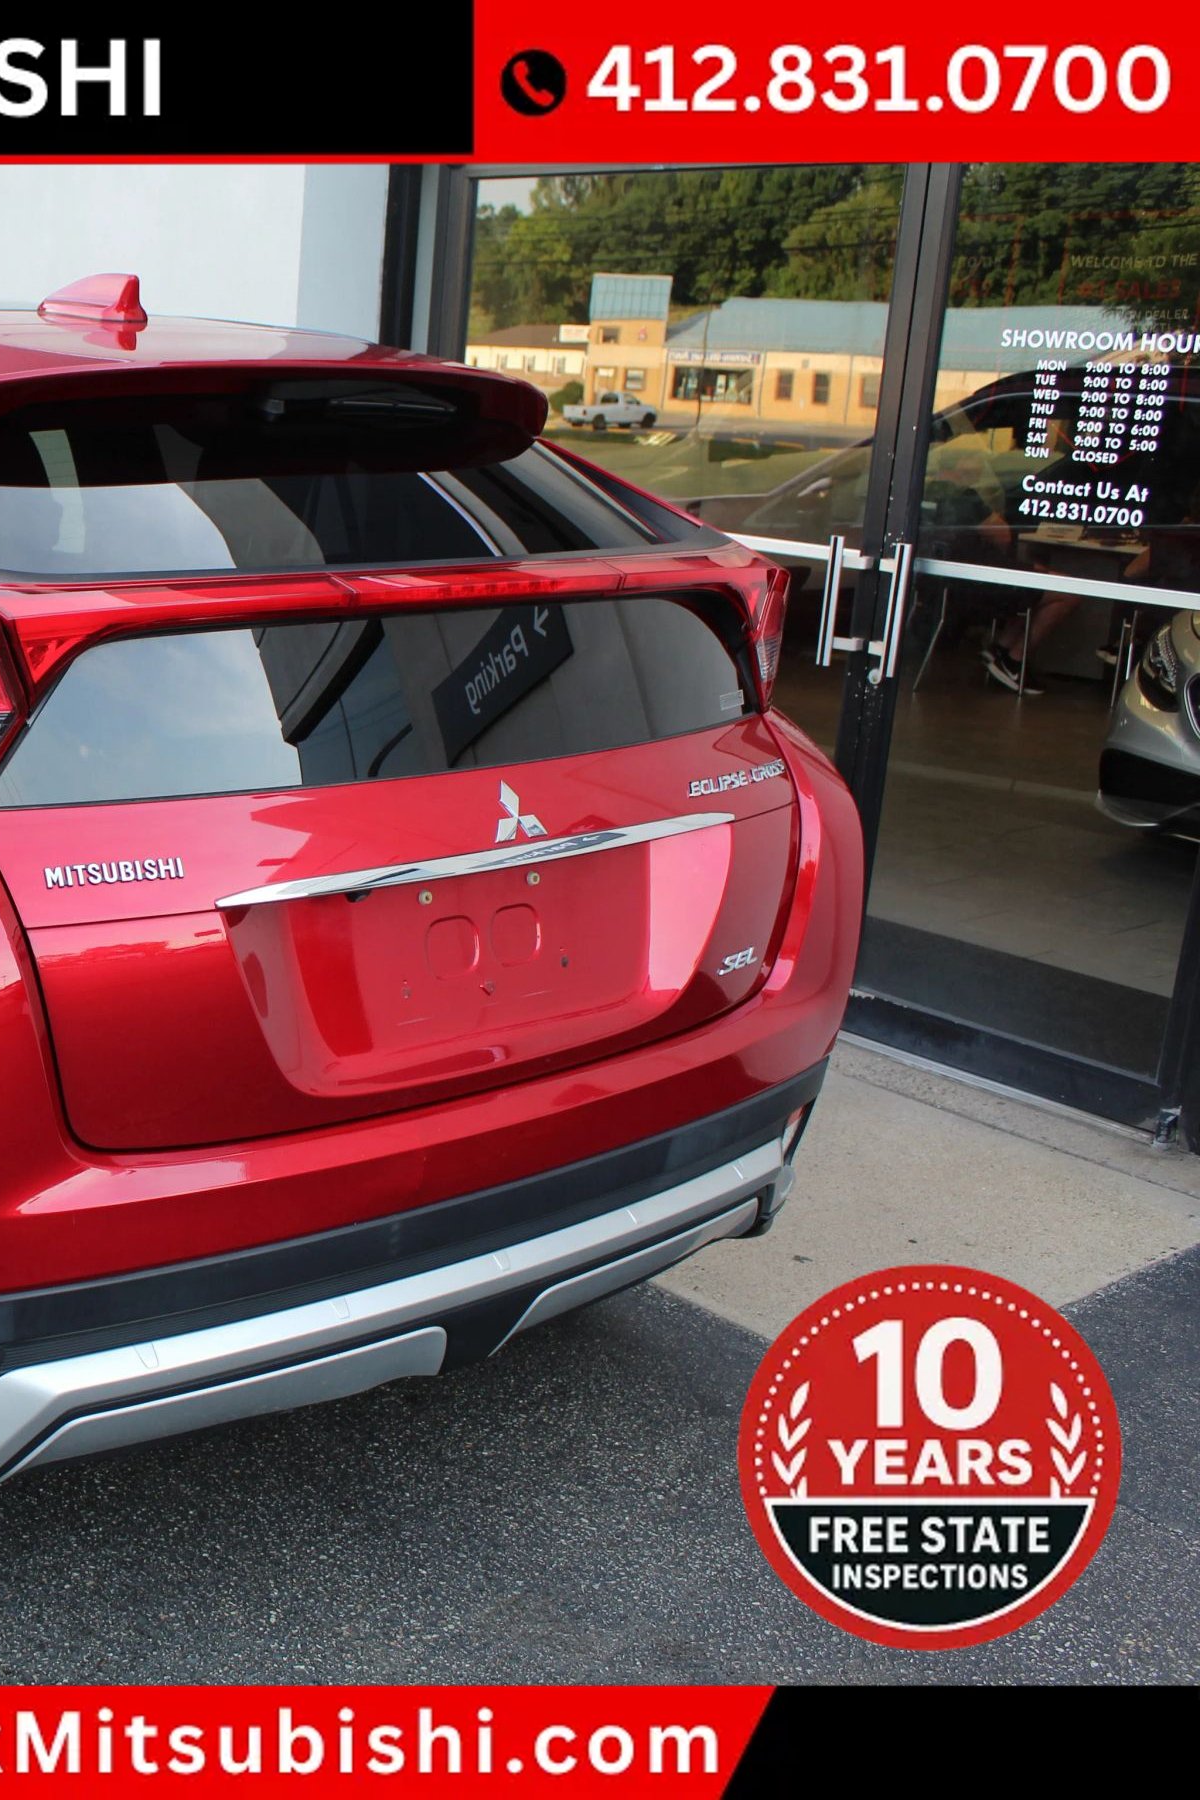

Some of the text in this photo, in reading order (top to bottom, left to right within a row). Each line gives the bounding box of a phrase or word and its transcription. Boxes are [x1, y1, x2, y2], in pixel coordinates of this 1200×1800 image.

[1071, 255, 1143, 269] WELCOME
[1171, 253, 1198, 267] THE
[1001, 329, 1134, 351] SHOWROOM
[1037, 360, 1170, 376] MON 9:00 TO 8:00
[1035, 374, 1168, 391] TUE 9:00 TO 8:00
[1033, 389, 1165, 406] WED 9:00 TO 8:00
[1031, 403, 1162, 421] THU 9:00 TO 8:00
[1028, 418, 1159, 437] FRI 9:00 TO 6:00
[1026, 432, 1157, 452] SAT 9:00 TO 5:00
[1024, 447, 1118, 464] SUN CLOSED
[1022, 474, 1149, 503] Contact Us At
[1019, 498, 1143, 527] 412.831.0700
[688, 758, 785, 797] ECLIPSE CROSS
[44, 857, 185, 889] MITSUBISHI
[717, 946, 758, 976] SEL
